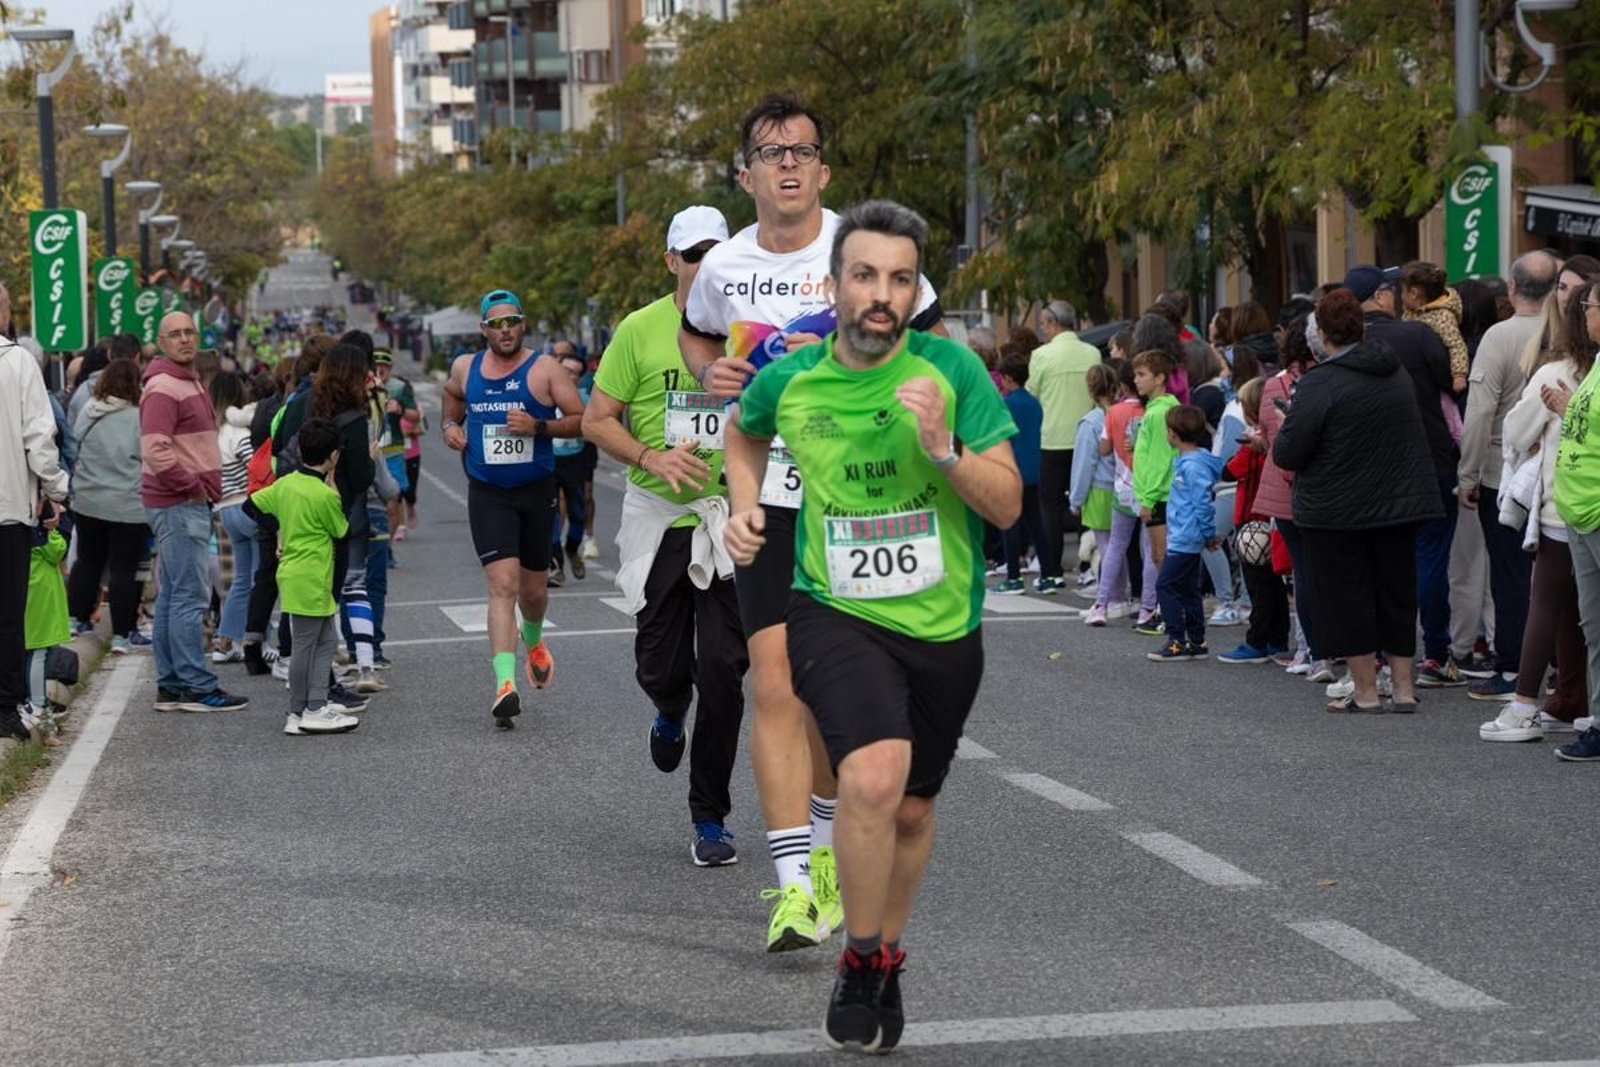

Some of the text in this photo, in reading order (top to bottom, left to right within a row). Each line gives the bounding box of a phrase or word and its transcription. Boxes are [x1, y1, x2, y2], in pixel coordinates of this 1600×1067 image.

[49, 258, 66, 346] CSIF
[662, 371, 679, 390] 17
[691, 413, 719, 435] 10
[493, 440, 524, 455] 280
[784, 465, 801, 491] 5
[844, 459, 897, 482] XI RUN
[866, 485, 884, 499] for
[849, 544, 918, 579] 206
